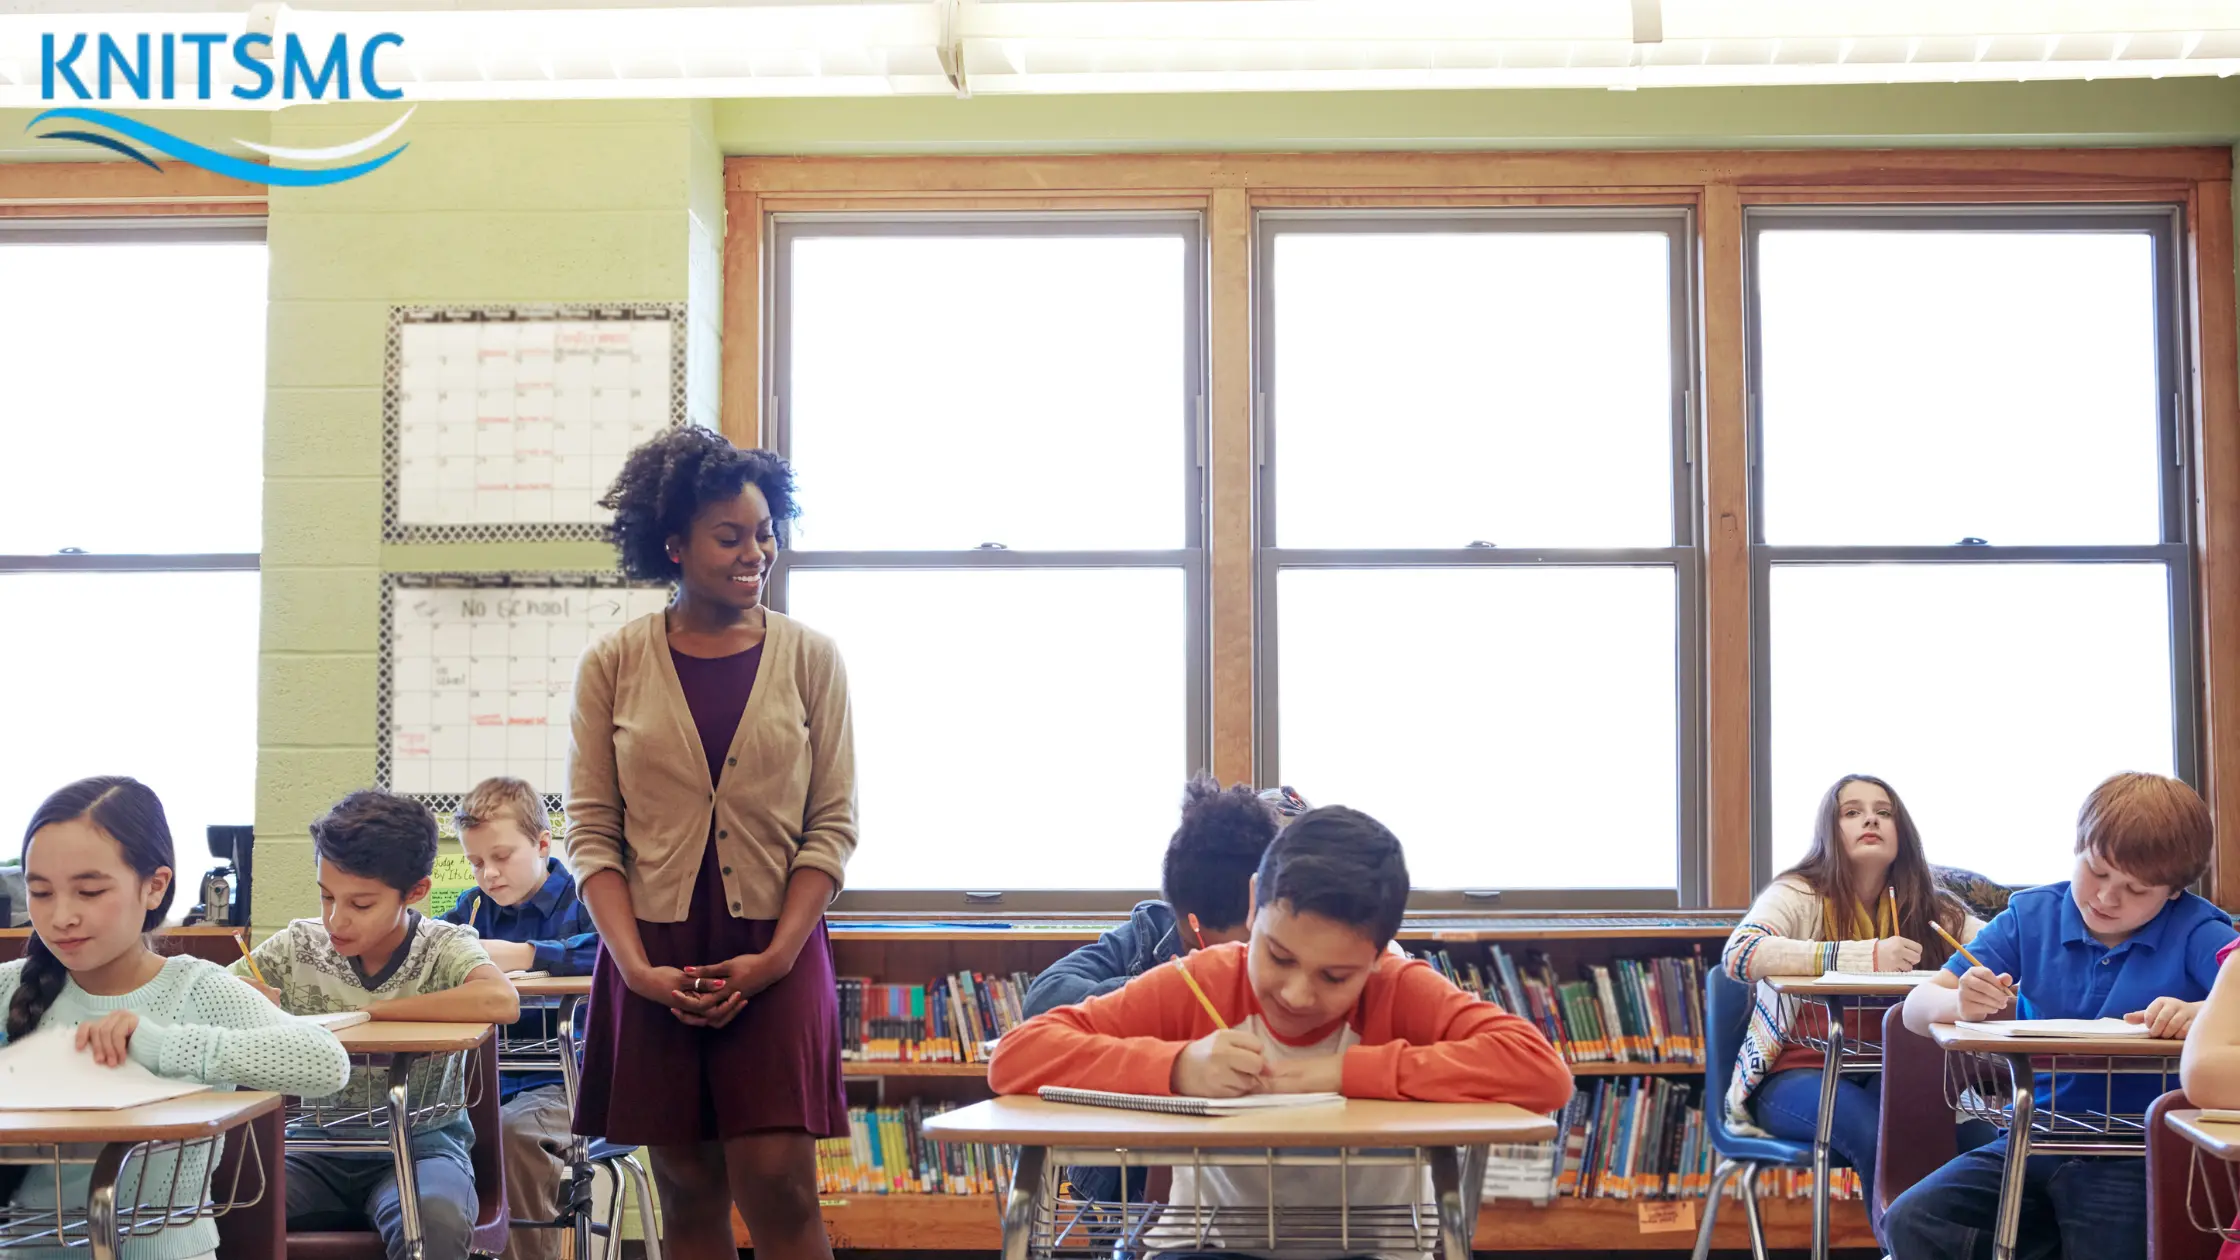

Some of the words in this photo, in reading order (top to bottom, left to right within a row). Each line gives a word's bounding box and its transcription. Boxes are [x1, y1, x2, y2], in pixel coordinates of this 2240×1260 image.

[461, 598, 487, 618] No
[434, 868, 445, 882] By
[447, 868, 462, 880] Its
